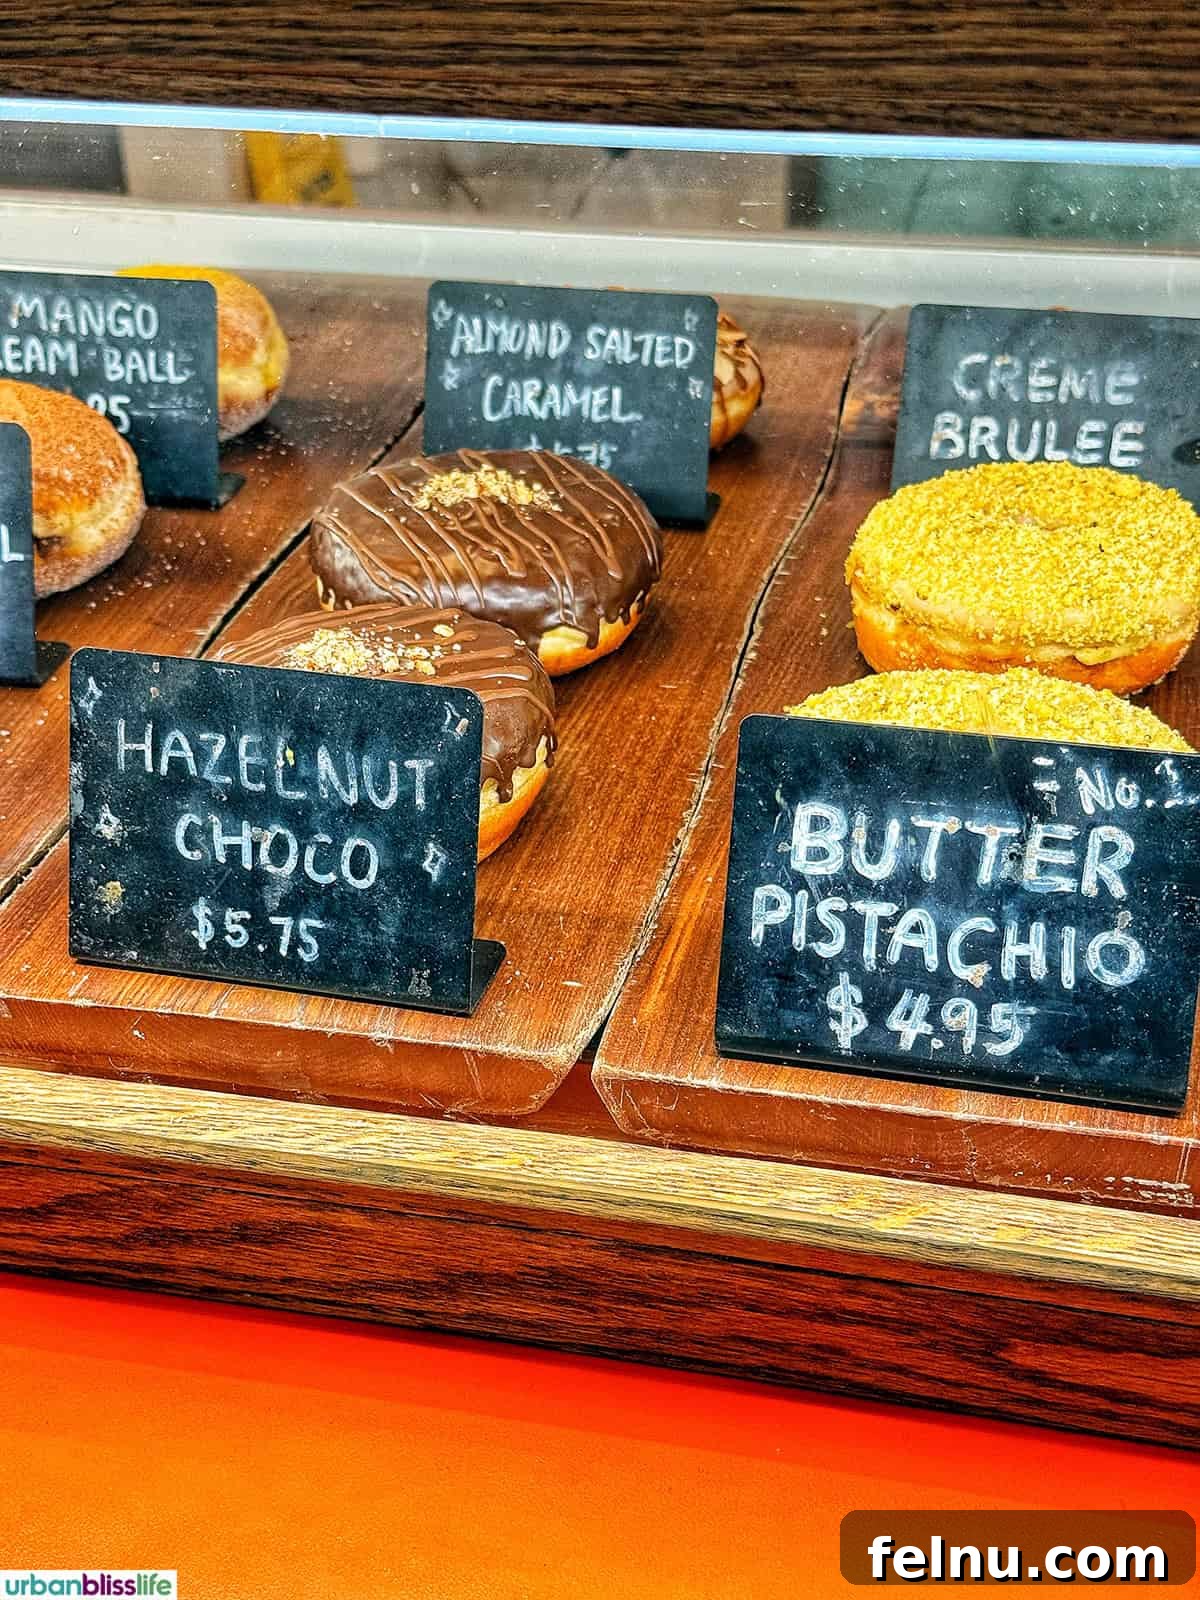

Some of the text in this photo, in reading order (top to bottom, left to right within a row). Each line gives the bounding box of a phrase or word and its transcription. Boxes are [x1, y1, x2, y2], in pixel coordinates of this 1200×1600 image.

[8, 295, 160, 340] MANGO
[449, 314, 696, 369] ALMOND SALTED
[0, 335, 194, 385] EAM BALL
[952, 353, 1141, 406] CREME
[481, 373, 644, 423] CARAMEL
[929, 410, 1146, 468] BRULEE
[116, 717, 435, 812] HAZELNUT
[174, 811, 380, 890] CHOCO
[789, 801, 1136, 900] BUTTER
[190, 896, 326, 963] $5.75
[750, 884, 1147, 990] PISTACHIO
